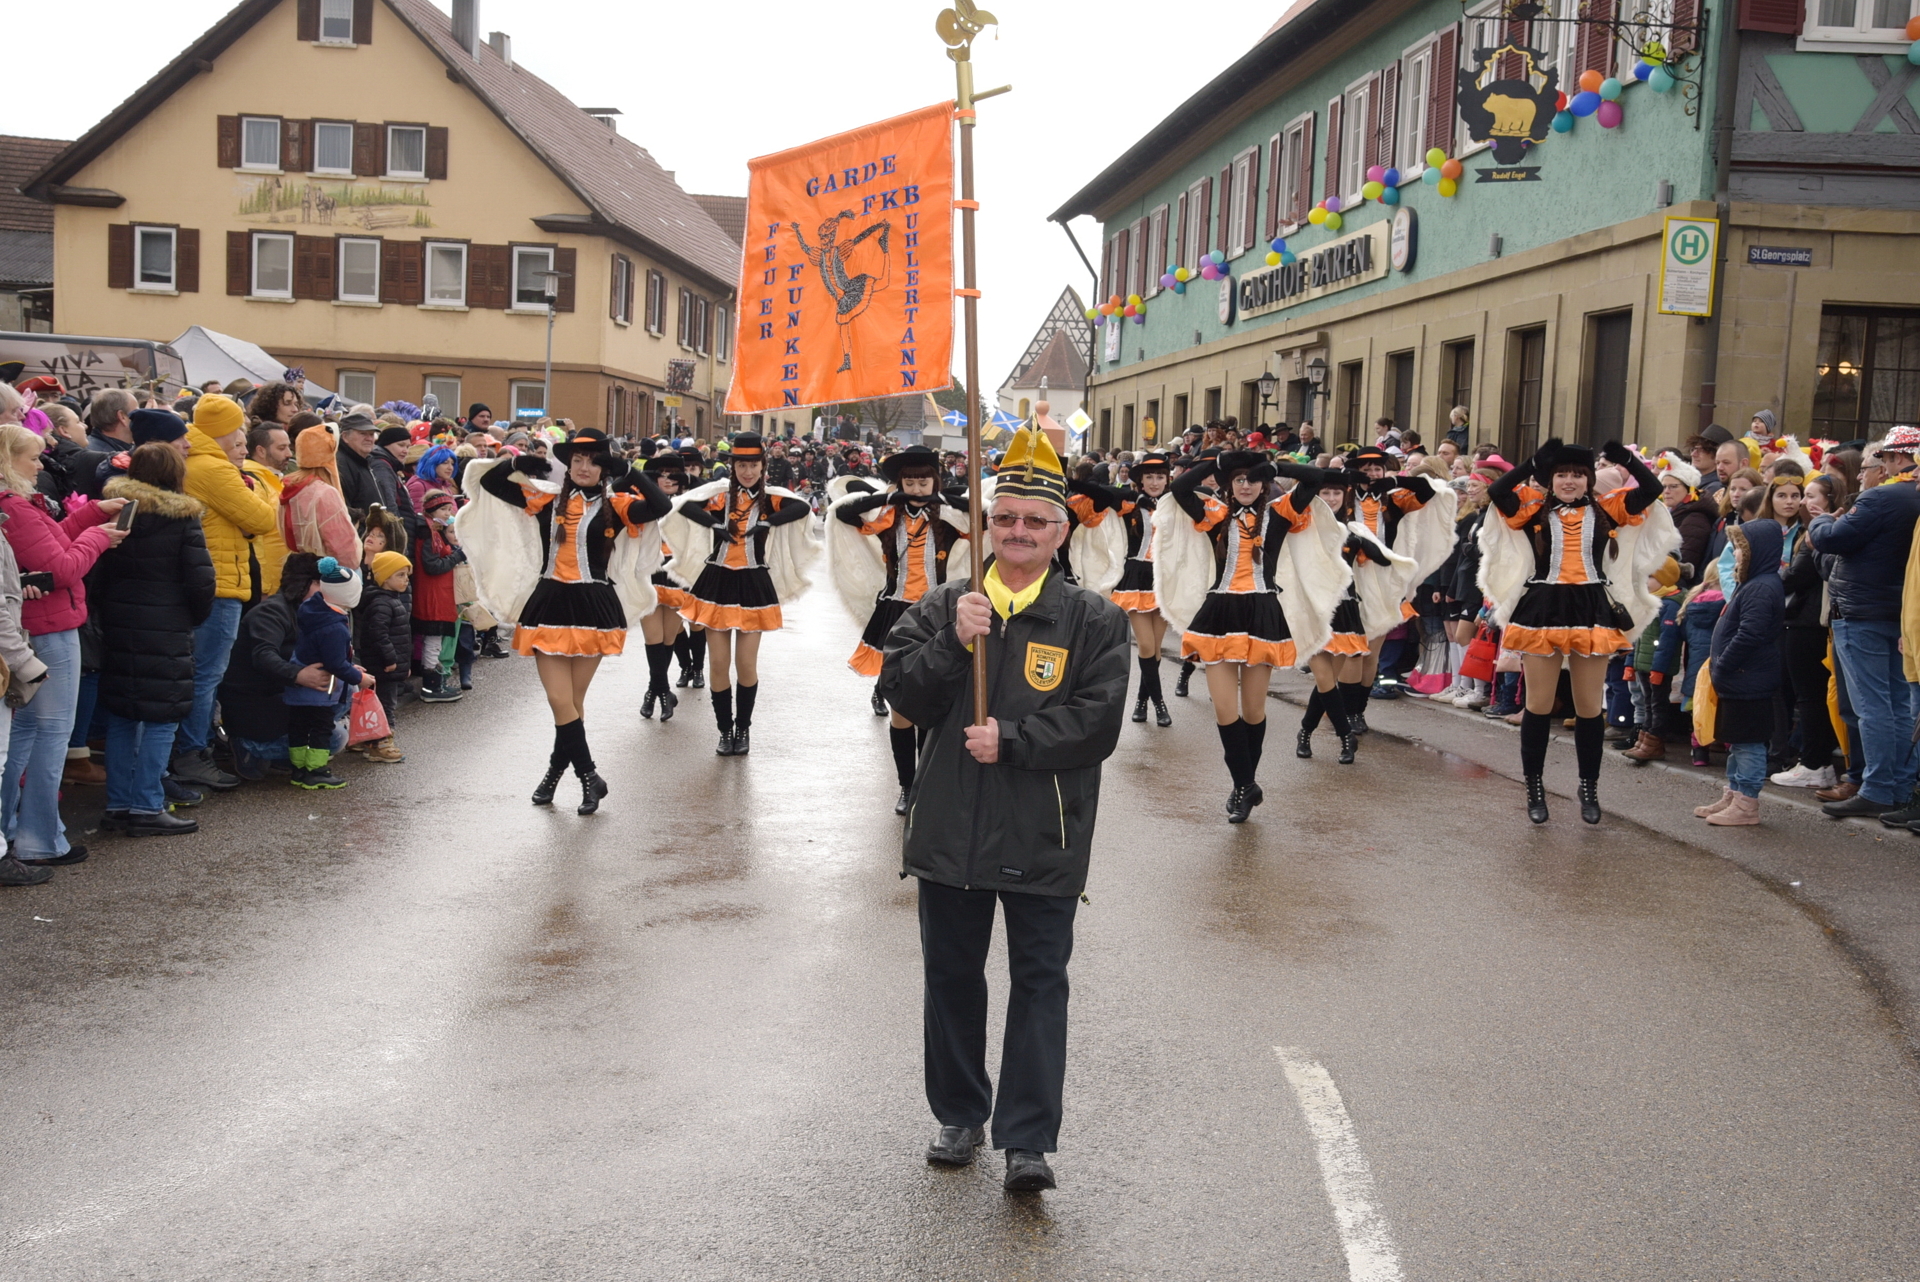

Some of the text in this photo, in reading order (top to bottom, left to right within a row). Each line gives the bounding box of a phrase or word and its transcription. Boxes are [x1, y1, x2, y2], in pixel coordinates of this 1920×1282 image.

[806, 154, 897, 197] GARDE
[1492, 170, 1526, 180] Rudolf Engel
[1680, 233, 1700, 256] H
[759, 222, 780, 340] FEUER
[1239, 234, 1371, 311] GASTHOF BÄREN
[781, 263, 804, 406] FUNKEN
[41, 350, 103, 375] VIVA
[62, 371, 96, 391] LA
